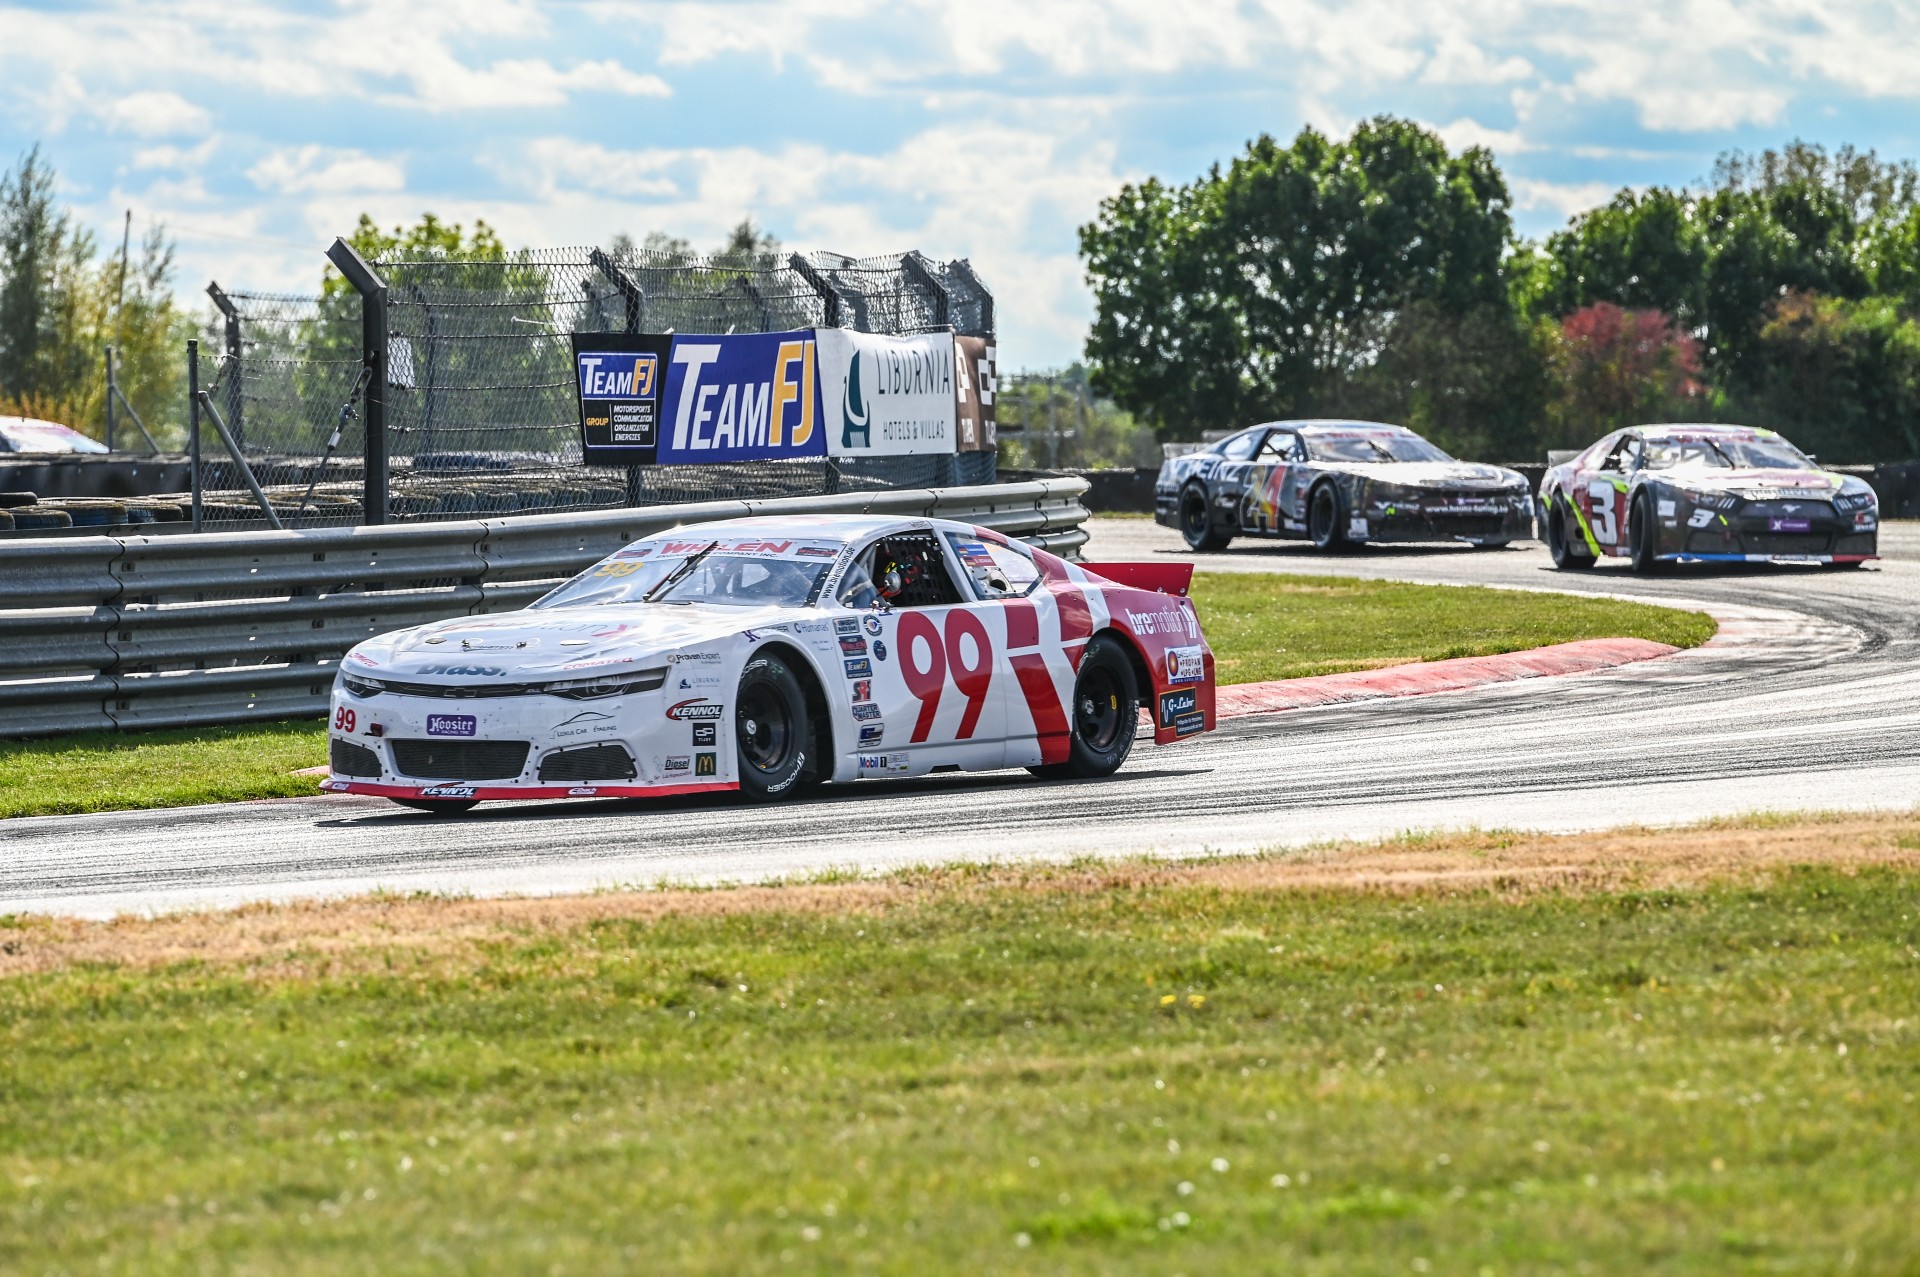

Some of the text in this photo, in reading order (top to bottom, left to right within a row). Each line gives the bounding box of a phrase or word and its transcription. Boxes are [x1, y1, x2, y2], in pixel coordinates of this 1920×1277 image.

[581, 358, 656, 395] TEAMFJ
[875, 349, 951, 395] LIBURNIA
[671, 340, 815, 450] TEAMFJ
[613, 405, 651, 413] MOTORSPORTS
[586, 417, 609, 426] GROUP
[613, 414, 653, 422] COMMUNICATION
[614, 424, 649, 432] ORGANIZATION
[883, 421, 911, 440] HOTELS
[913, 421, 918, 439] &
[920, 420, 945, 439] VILLAS
[614, 433, 641, 441] ENERGIES
[1588, 480, 1618, 545] 3
[1687, 508, 1715, 528] 3
[594, 561, 645, 578] 99
[1125, 605, 1188, 636] bremotion
[897, 607, 993, 743] 99
[334, 706, 356, 733] 99
[671, 706, 721, 716] KENNOL
[430, 717, 474, 732] Hoosier
[665, 759, 690, 769] Dipsel
[860, 756, 879, 768] Mobil
